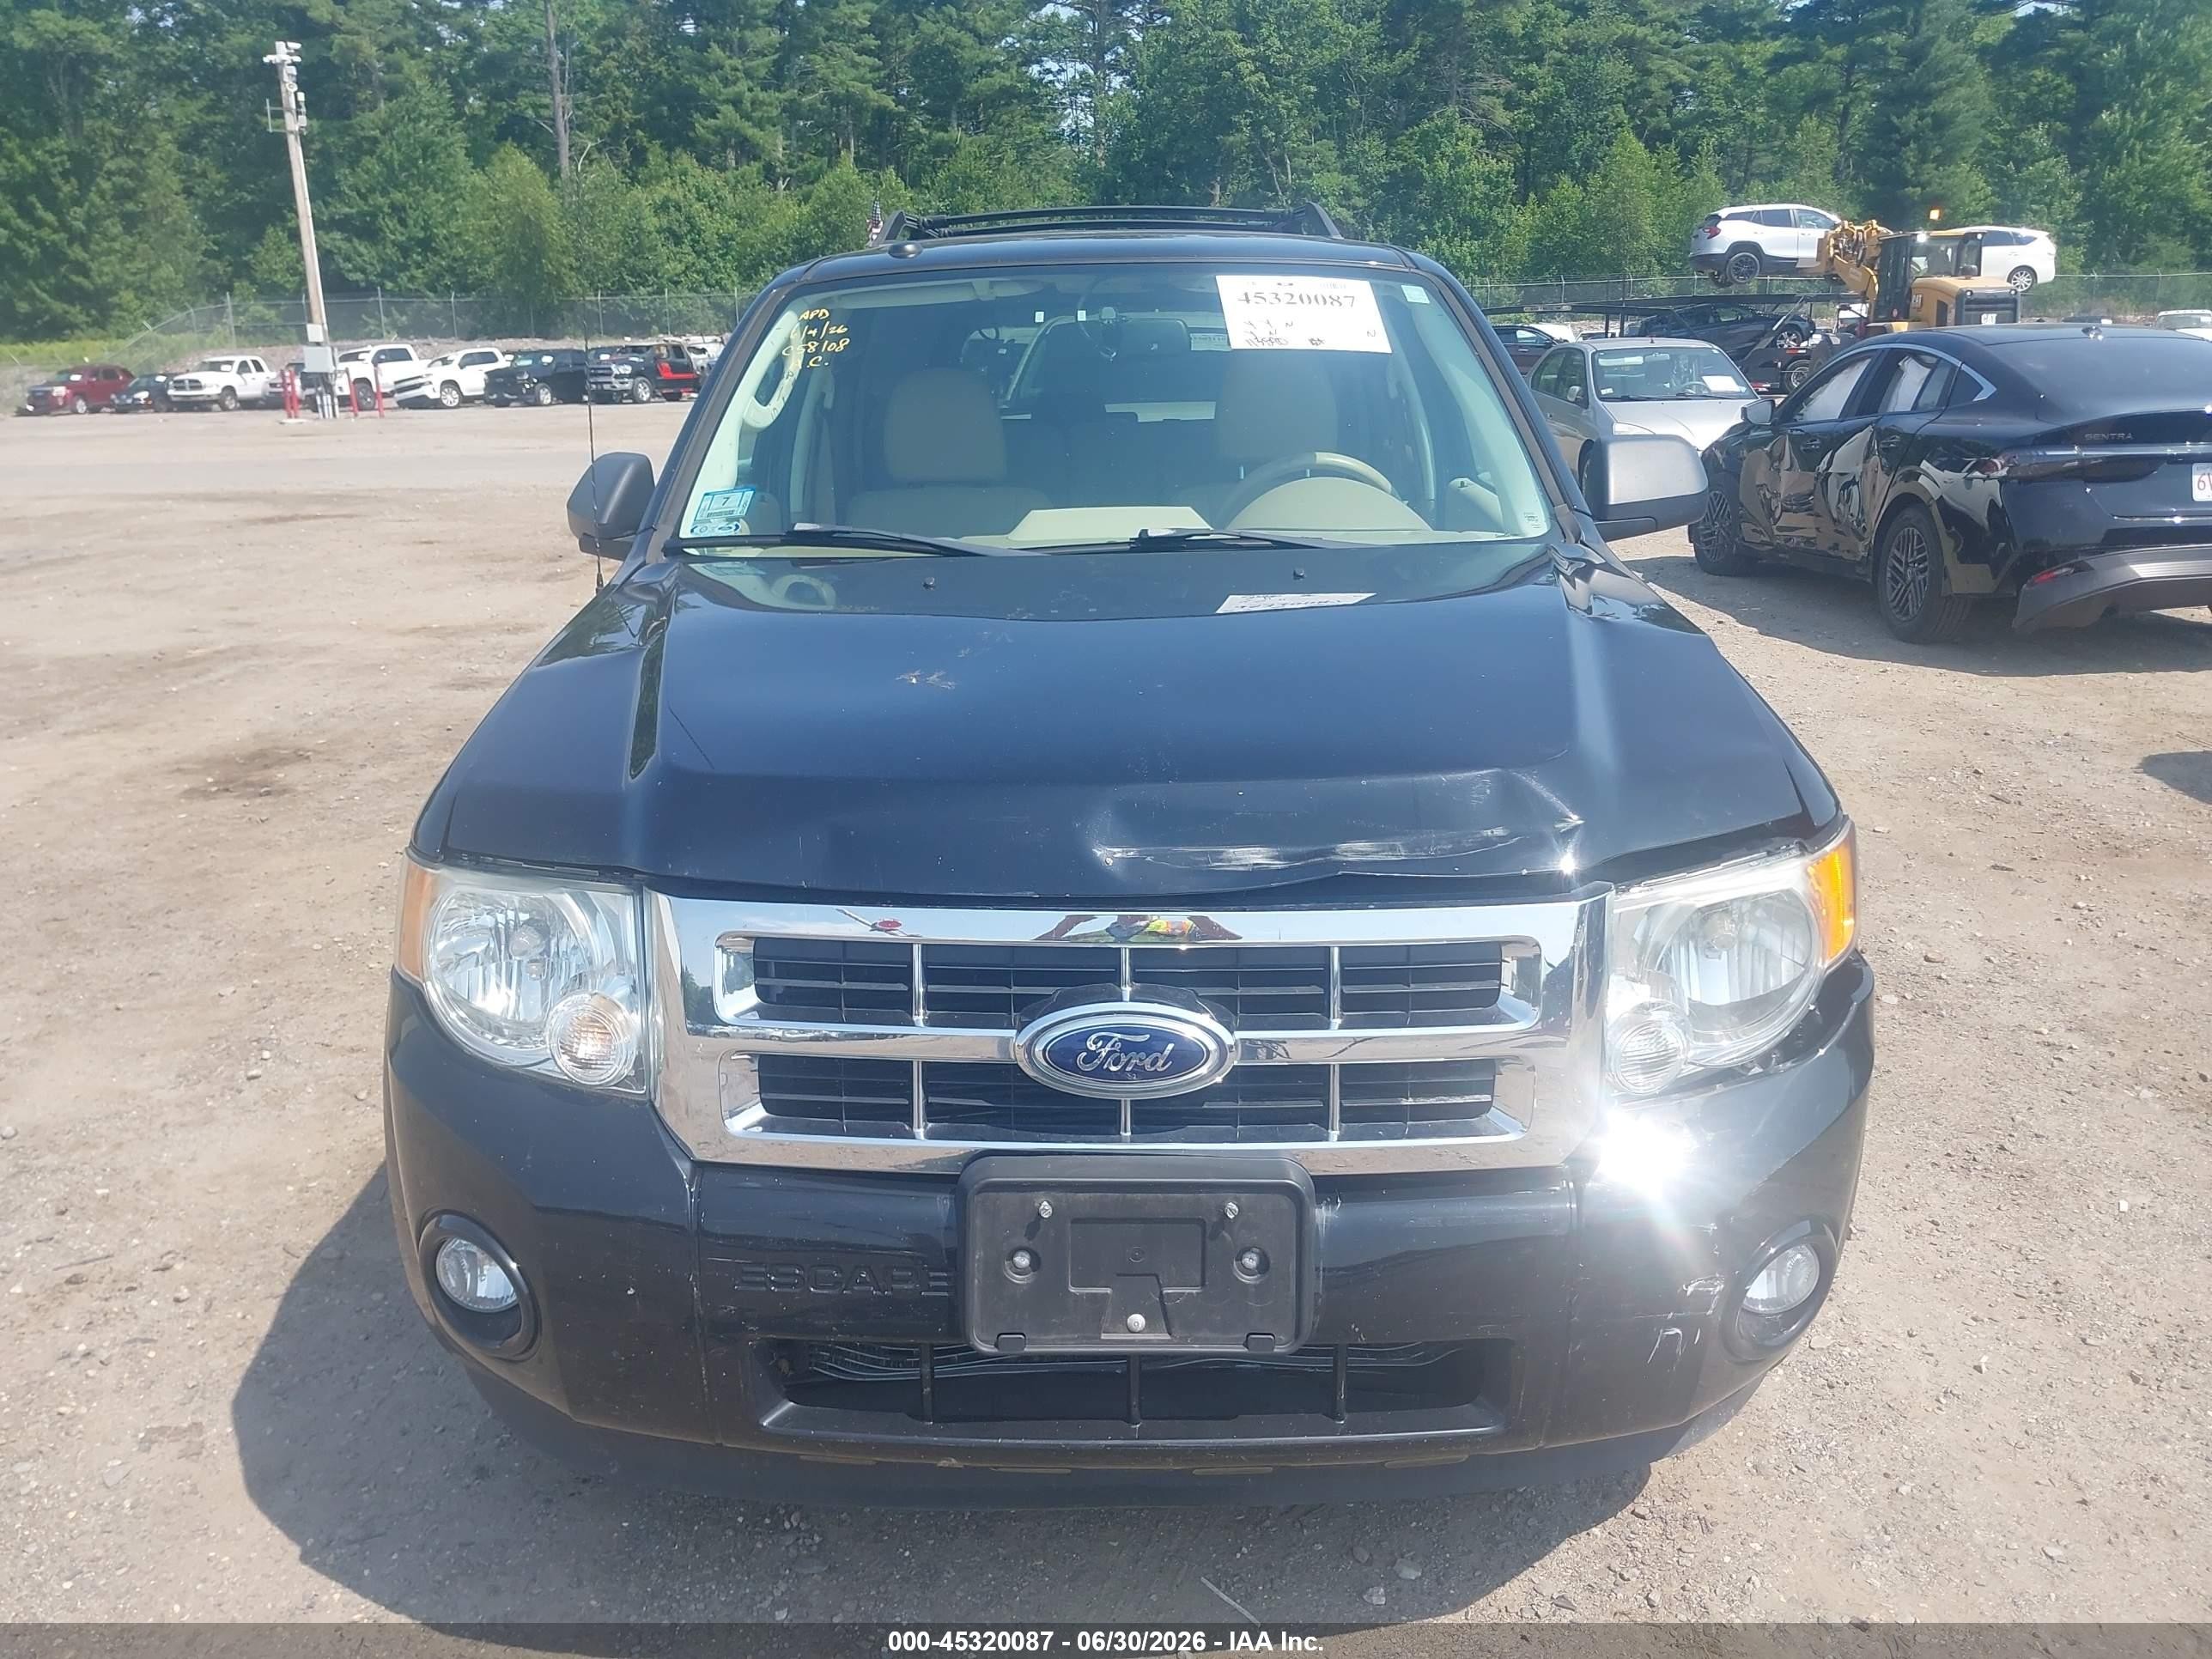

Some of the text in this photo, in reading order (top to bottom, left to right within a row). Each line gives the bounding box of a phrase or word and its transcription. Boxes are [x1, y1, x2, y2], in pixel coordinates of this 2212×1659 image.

[1238, 292, 1355, 307] 45320087
[1981, 313, 1997, 325] CAT
[722, 497, 731, 507] 7
[1077, 1032, 1175, 1072] Ford
[734, 1265, 955, 1296] ESCAPE
